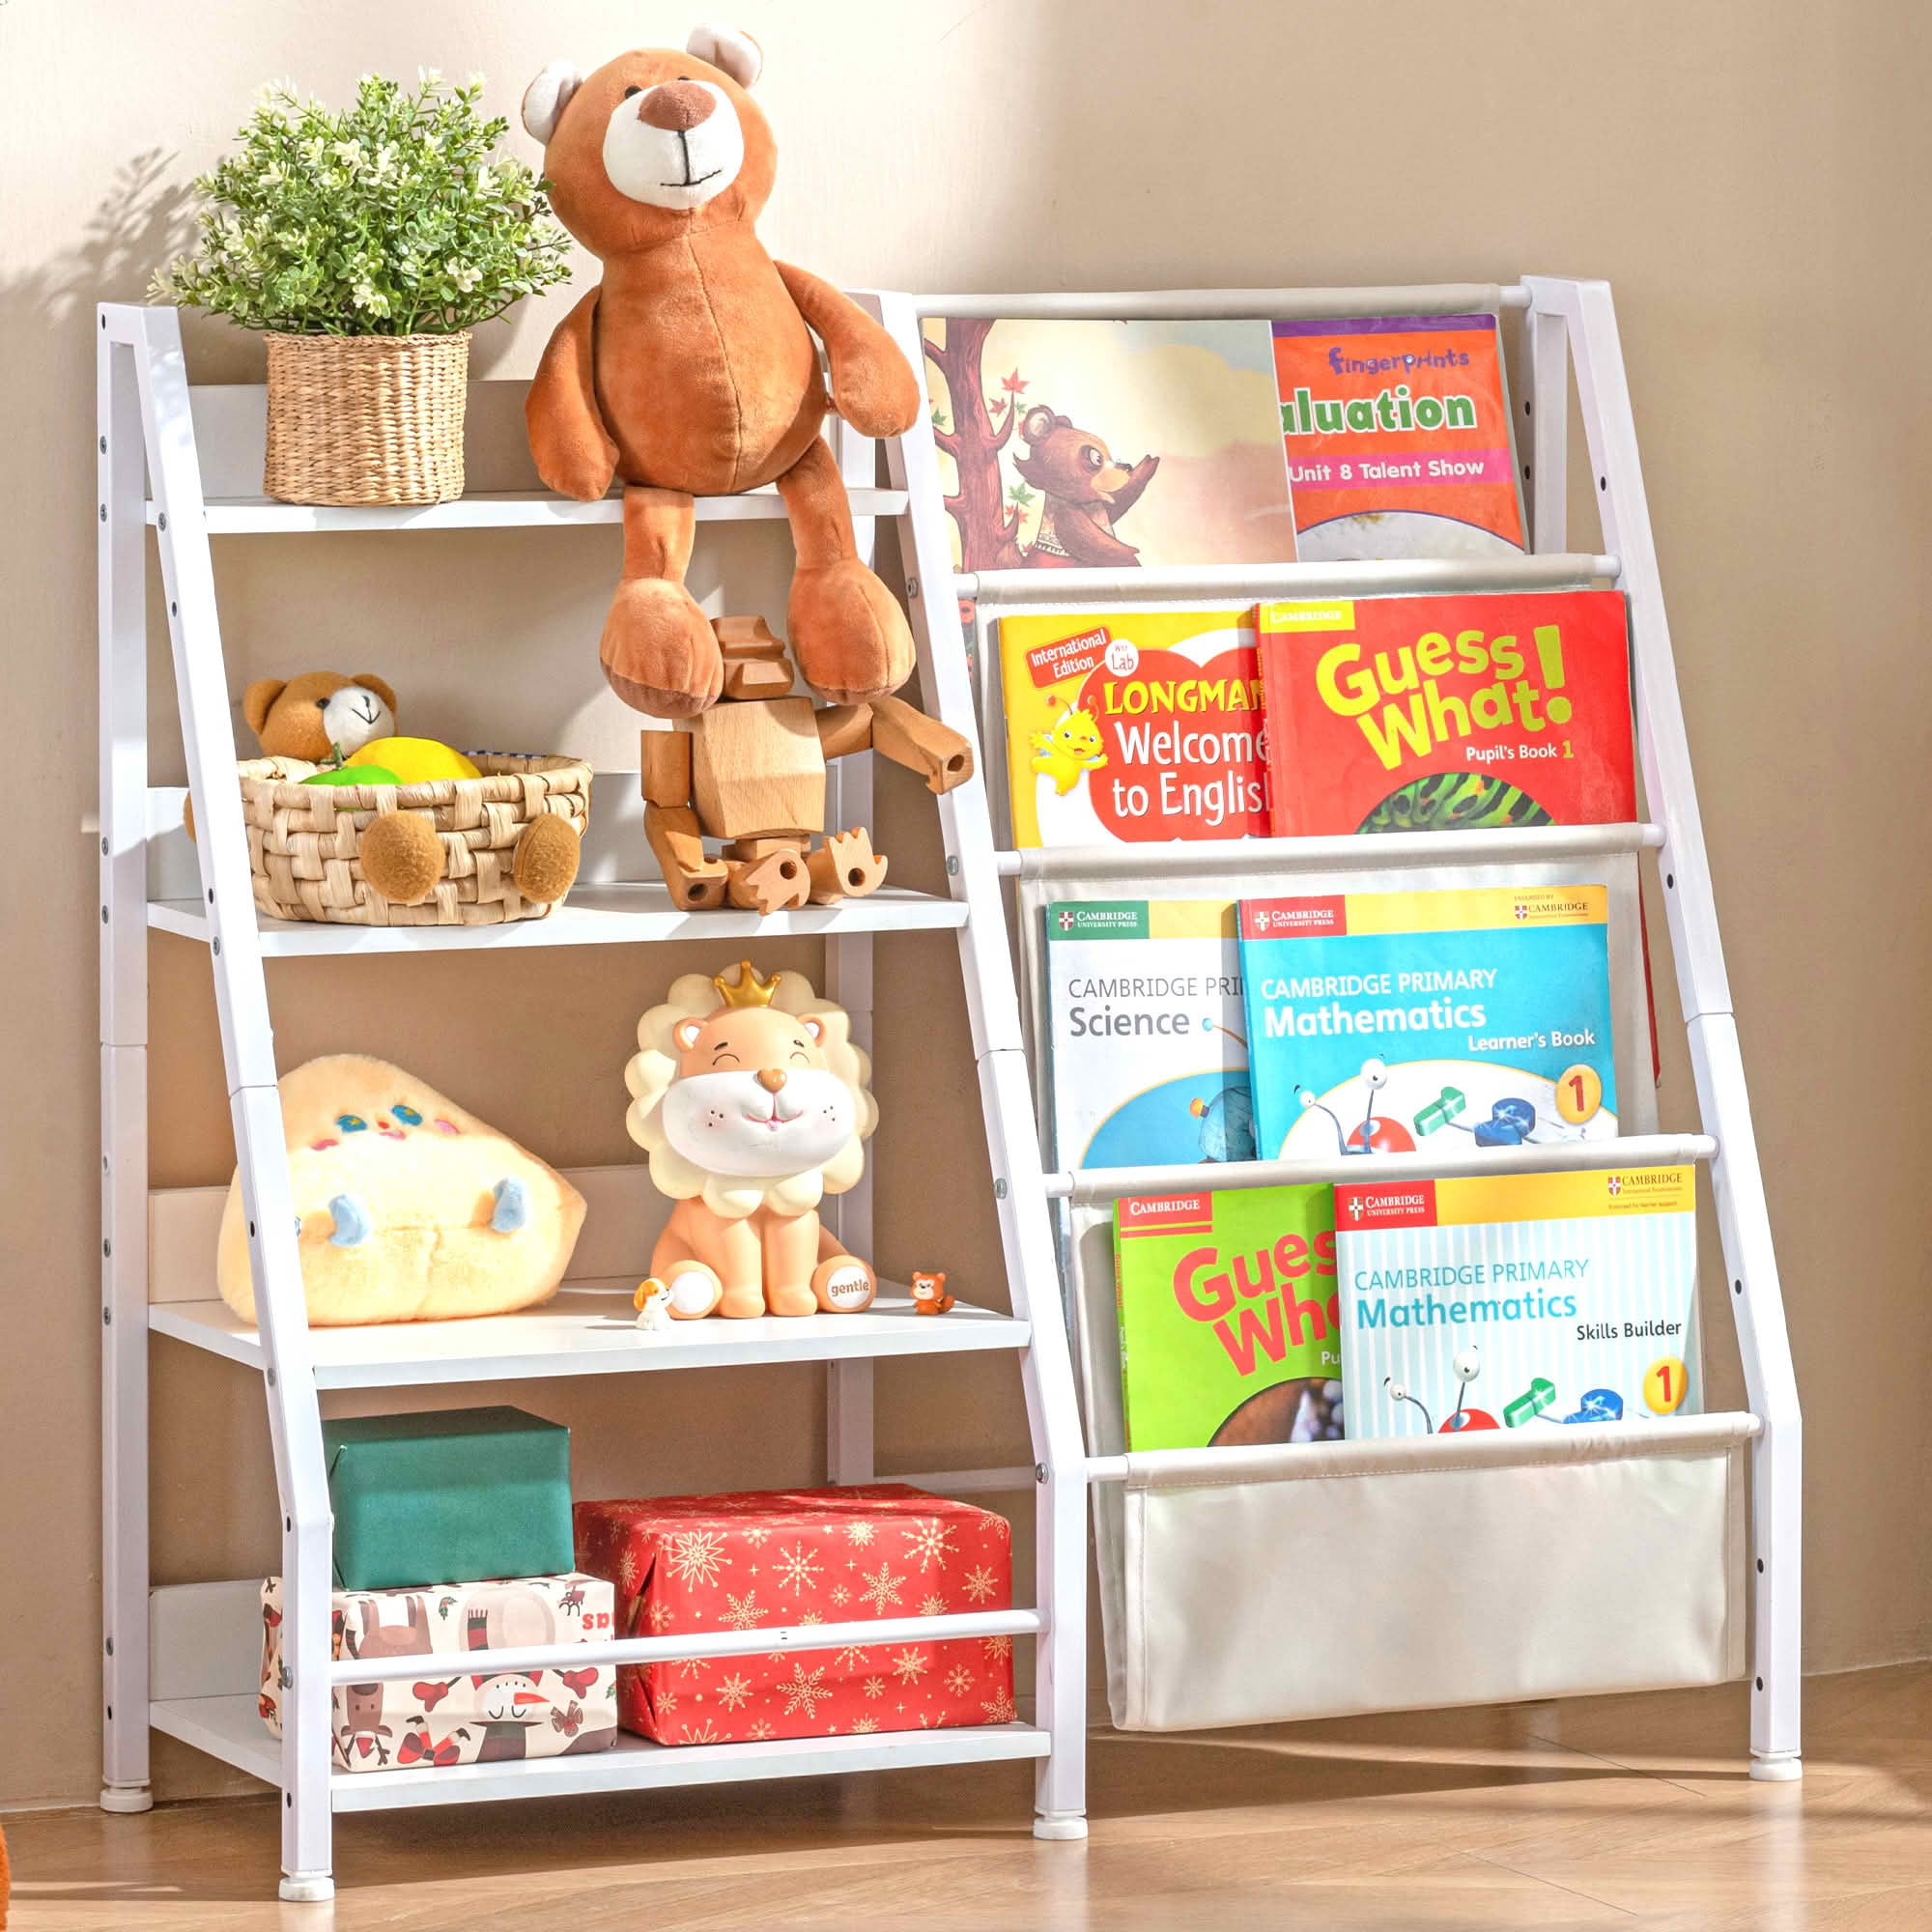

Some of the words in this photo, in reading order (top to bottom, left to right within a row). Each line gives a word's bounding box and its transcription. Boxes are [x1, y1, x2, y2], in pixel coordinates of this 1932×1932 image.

[1329, 347, 1469, 375] fingerprints
[1290, 465, 1330, 482] Unit
[1340, 464, 1352, 479] 8
[1359, 462, 1421, 480] Talent
[1429, 459, 1485, 477] Show
[1031, 629, 1107, 667] International
[1053, 655, 1094, 678] Edition
[1112, 653, 1135, 670] Lab
[1316, 630, 1524, 716] Guess
[1466, 746, 1515, 764] Pupil's
[1520, 744, 1557, 759] Book
[1562, 741, 1575, 758] 1
[1113, 779, 1149, 817] to
[1077, 911, 1137, 922] CAMBRIDGE
[1272, 910, 1334, 922] CAMBRIDGE
[1529, 902, 1588, 913] CAMBRIDGE
[1068, 978, 1198, 998] CAMBRIDGE
[1207, 977, 1244, 996] PRI
[1261, 974, 1391, 1000] CAMBRIDGE
[1399, 969, 1497, 994] PRIMARY
[1069, 1005, 1190, 1037] Science
[1264, 997, 1487, 1038] Mathematics
[1468, 1032, 1547, 1051] Learner's
[1552, 1029, 1595, 1047] Book
[1568, 1074, 1585, 1112] 1
[1622, 1173, 1683, 1186] CAMBRIDGE
[1130, 1199, 1200, 1215] CAMBRIDGE
[1366, 1195, 1425, 1208] CAMBRIDGE
[1367, 1208, 1404, 1216] UNIVERSITY
[1355, 1264, 1485, 1291] CAMBRIDGE
[1493, 1259, 1589, 1284] PRIMARY
[831, 1280, 869, 1297] gentle
[1356, 1288, 1577, 1329] Mathematics
[1577, 1322, 1618, 1341] Skills
[1625, 1321, 1682, 1338] Builder
[1655, 1365, 1672, 1403] 1
